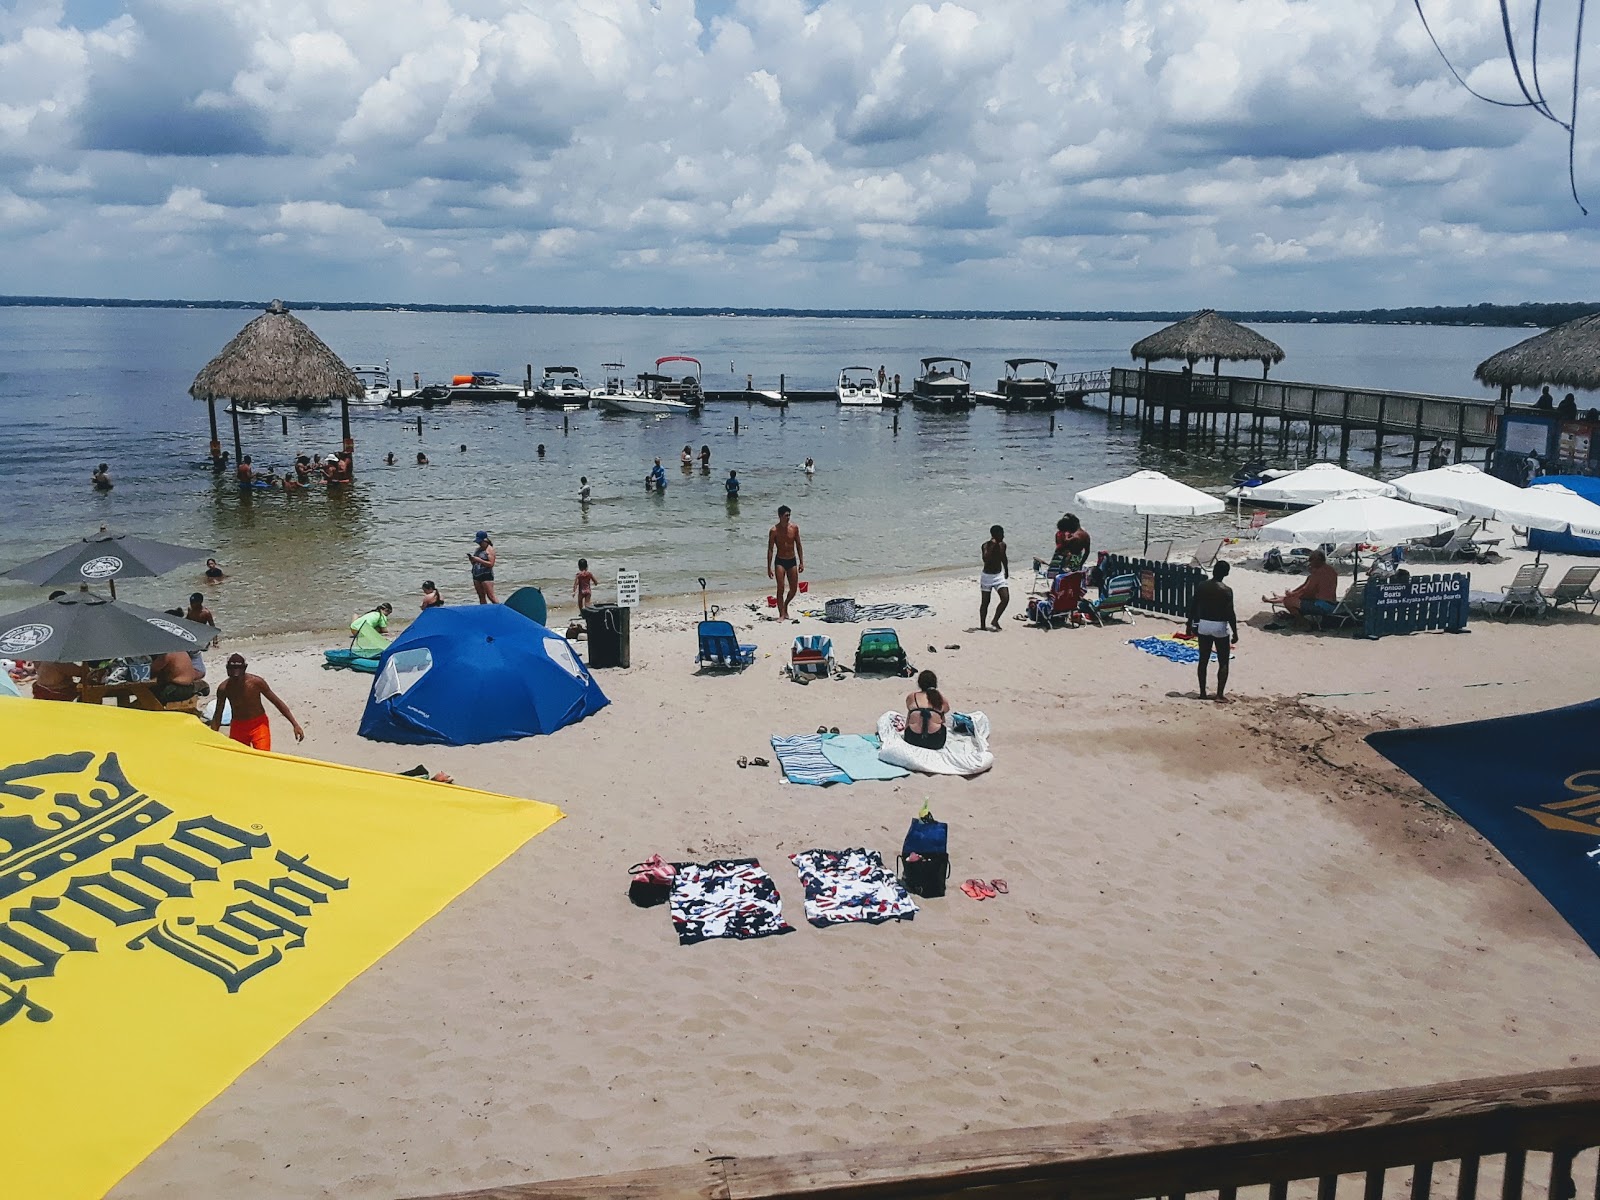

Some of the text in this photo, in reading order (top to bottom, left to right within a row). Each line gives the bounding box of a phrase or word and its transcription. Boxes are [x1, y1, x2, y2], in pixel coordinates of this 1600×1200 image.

[1411, 580, 1460, 594] RENTING
[0, 815, 272, 1026] orona
[126, 849, 350, 993] Light
